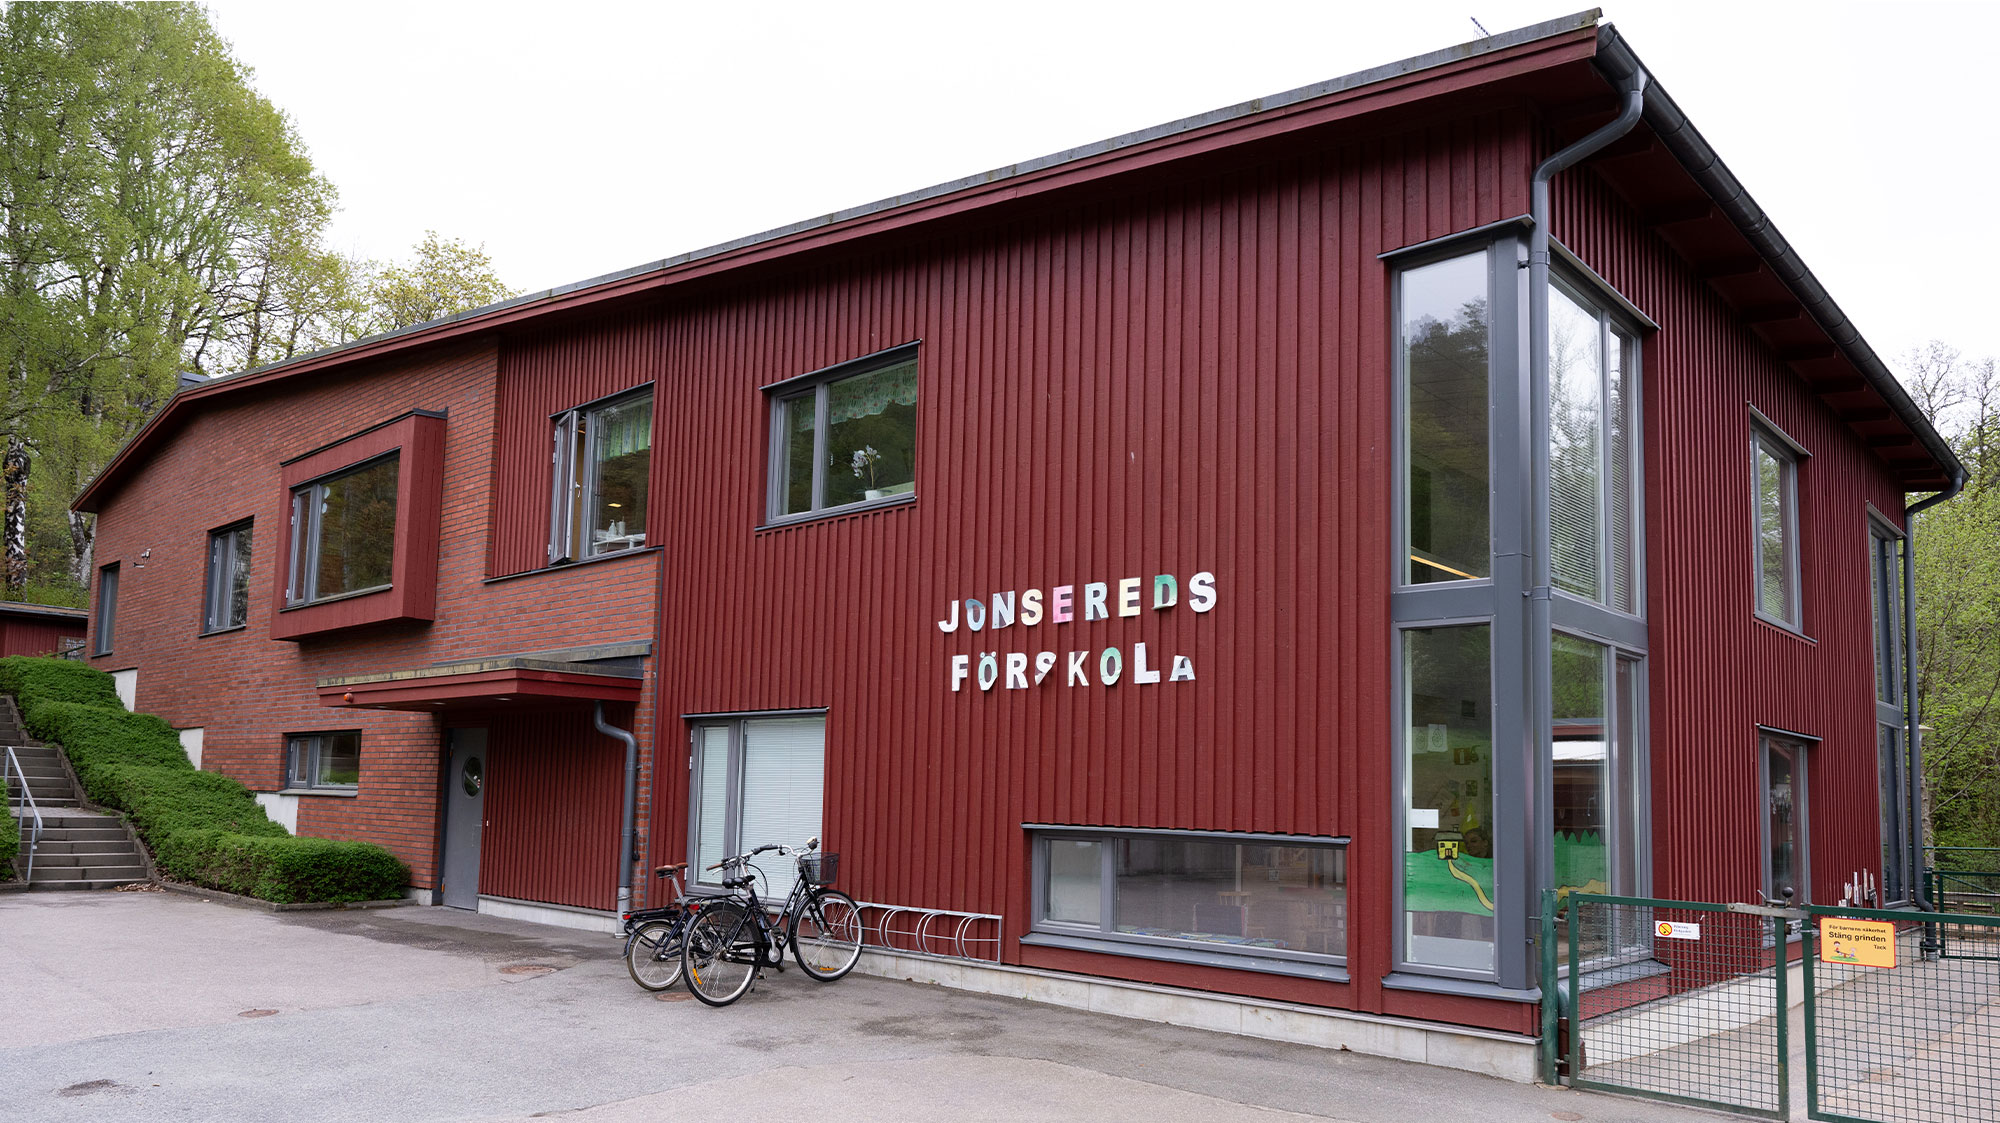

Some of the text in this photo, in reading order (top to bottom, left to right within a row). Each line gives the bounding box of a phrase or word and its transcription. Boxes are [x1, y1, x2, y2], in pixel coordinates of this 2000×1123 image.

[938, 571, 1217, 632] JONSEREDS
[951, 642, 1196, 691] FÖRSKOLA
[1828, 932, 1852, 941] Stäng
